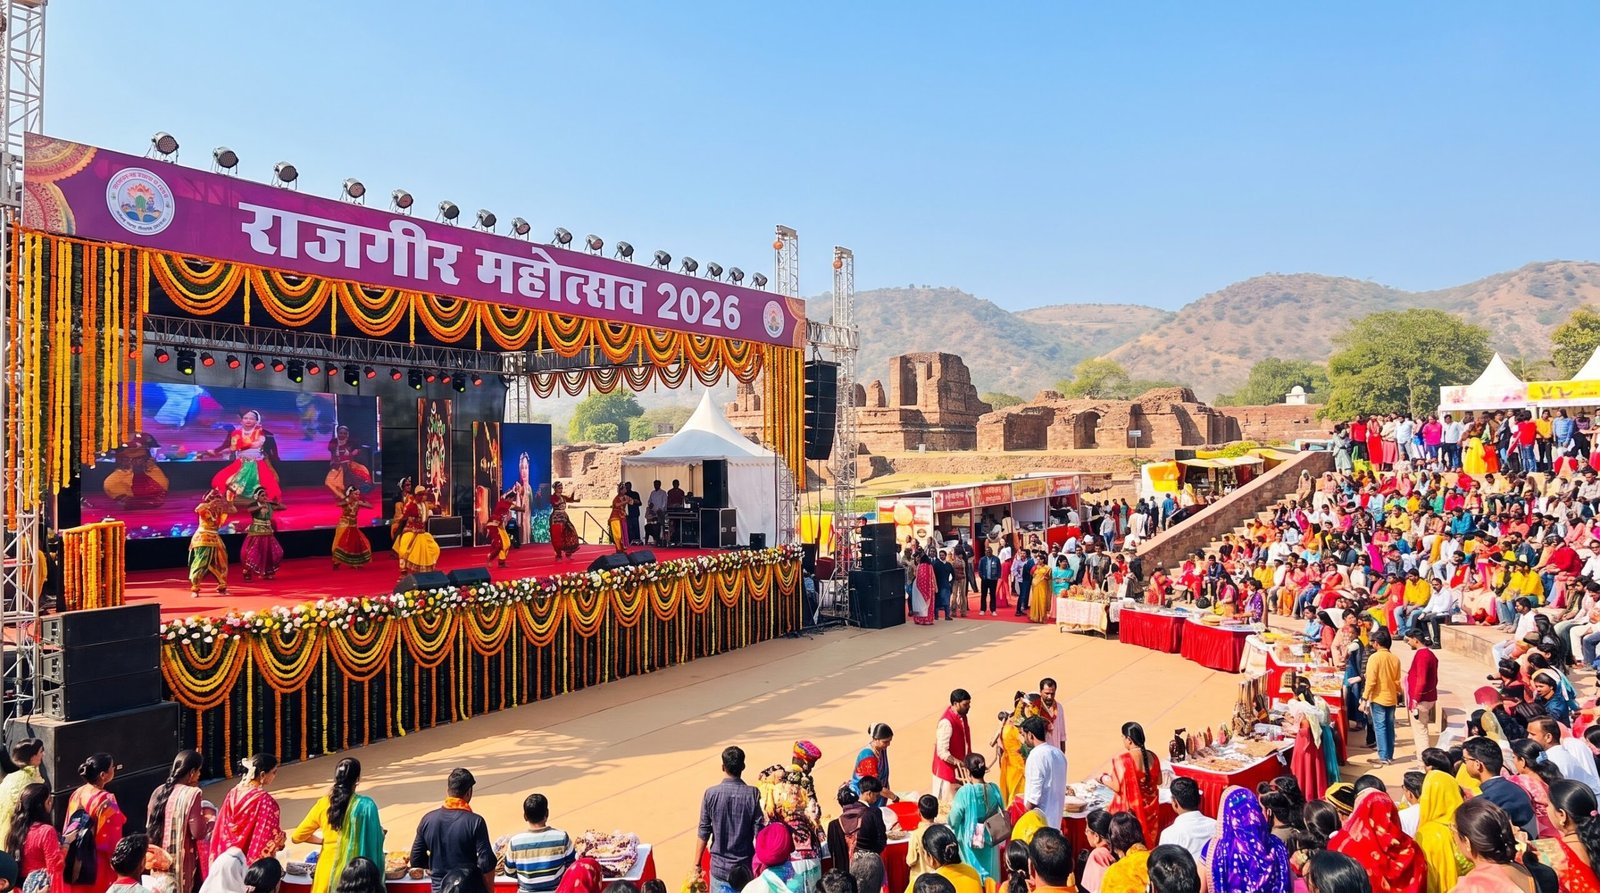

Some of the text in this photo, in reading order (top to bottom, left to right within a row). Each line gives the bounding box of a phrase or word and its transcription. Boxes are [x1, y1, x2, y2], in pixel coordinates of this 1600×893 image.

[238, 202, 463, 286] राजगीर
[475, 247, 647, 315] महोत्सव
[657, 282, 741, 331] 2026
